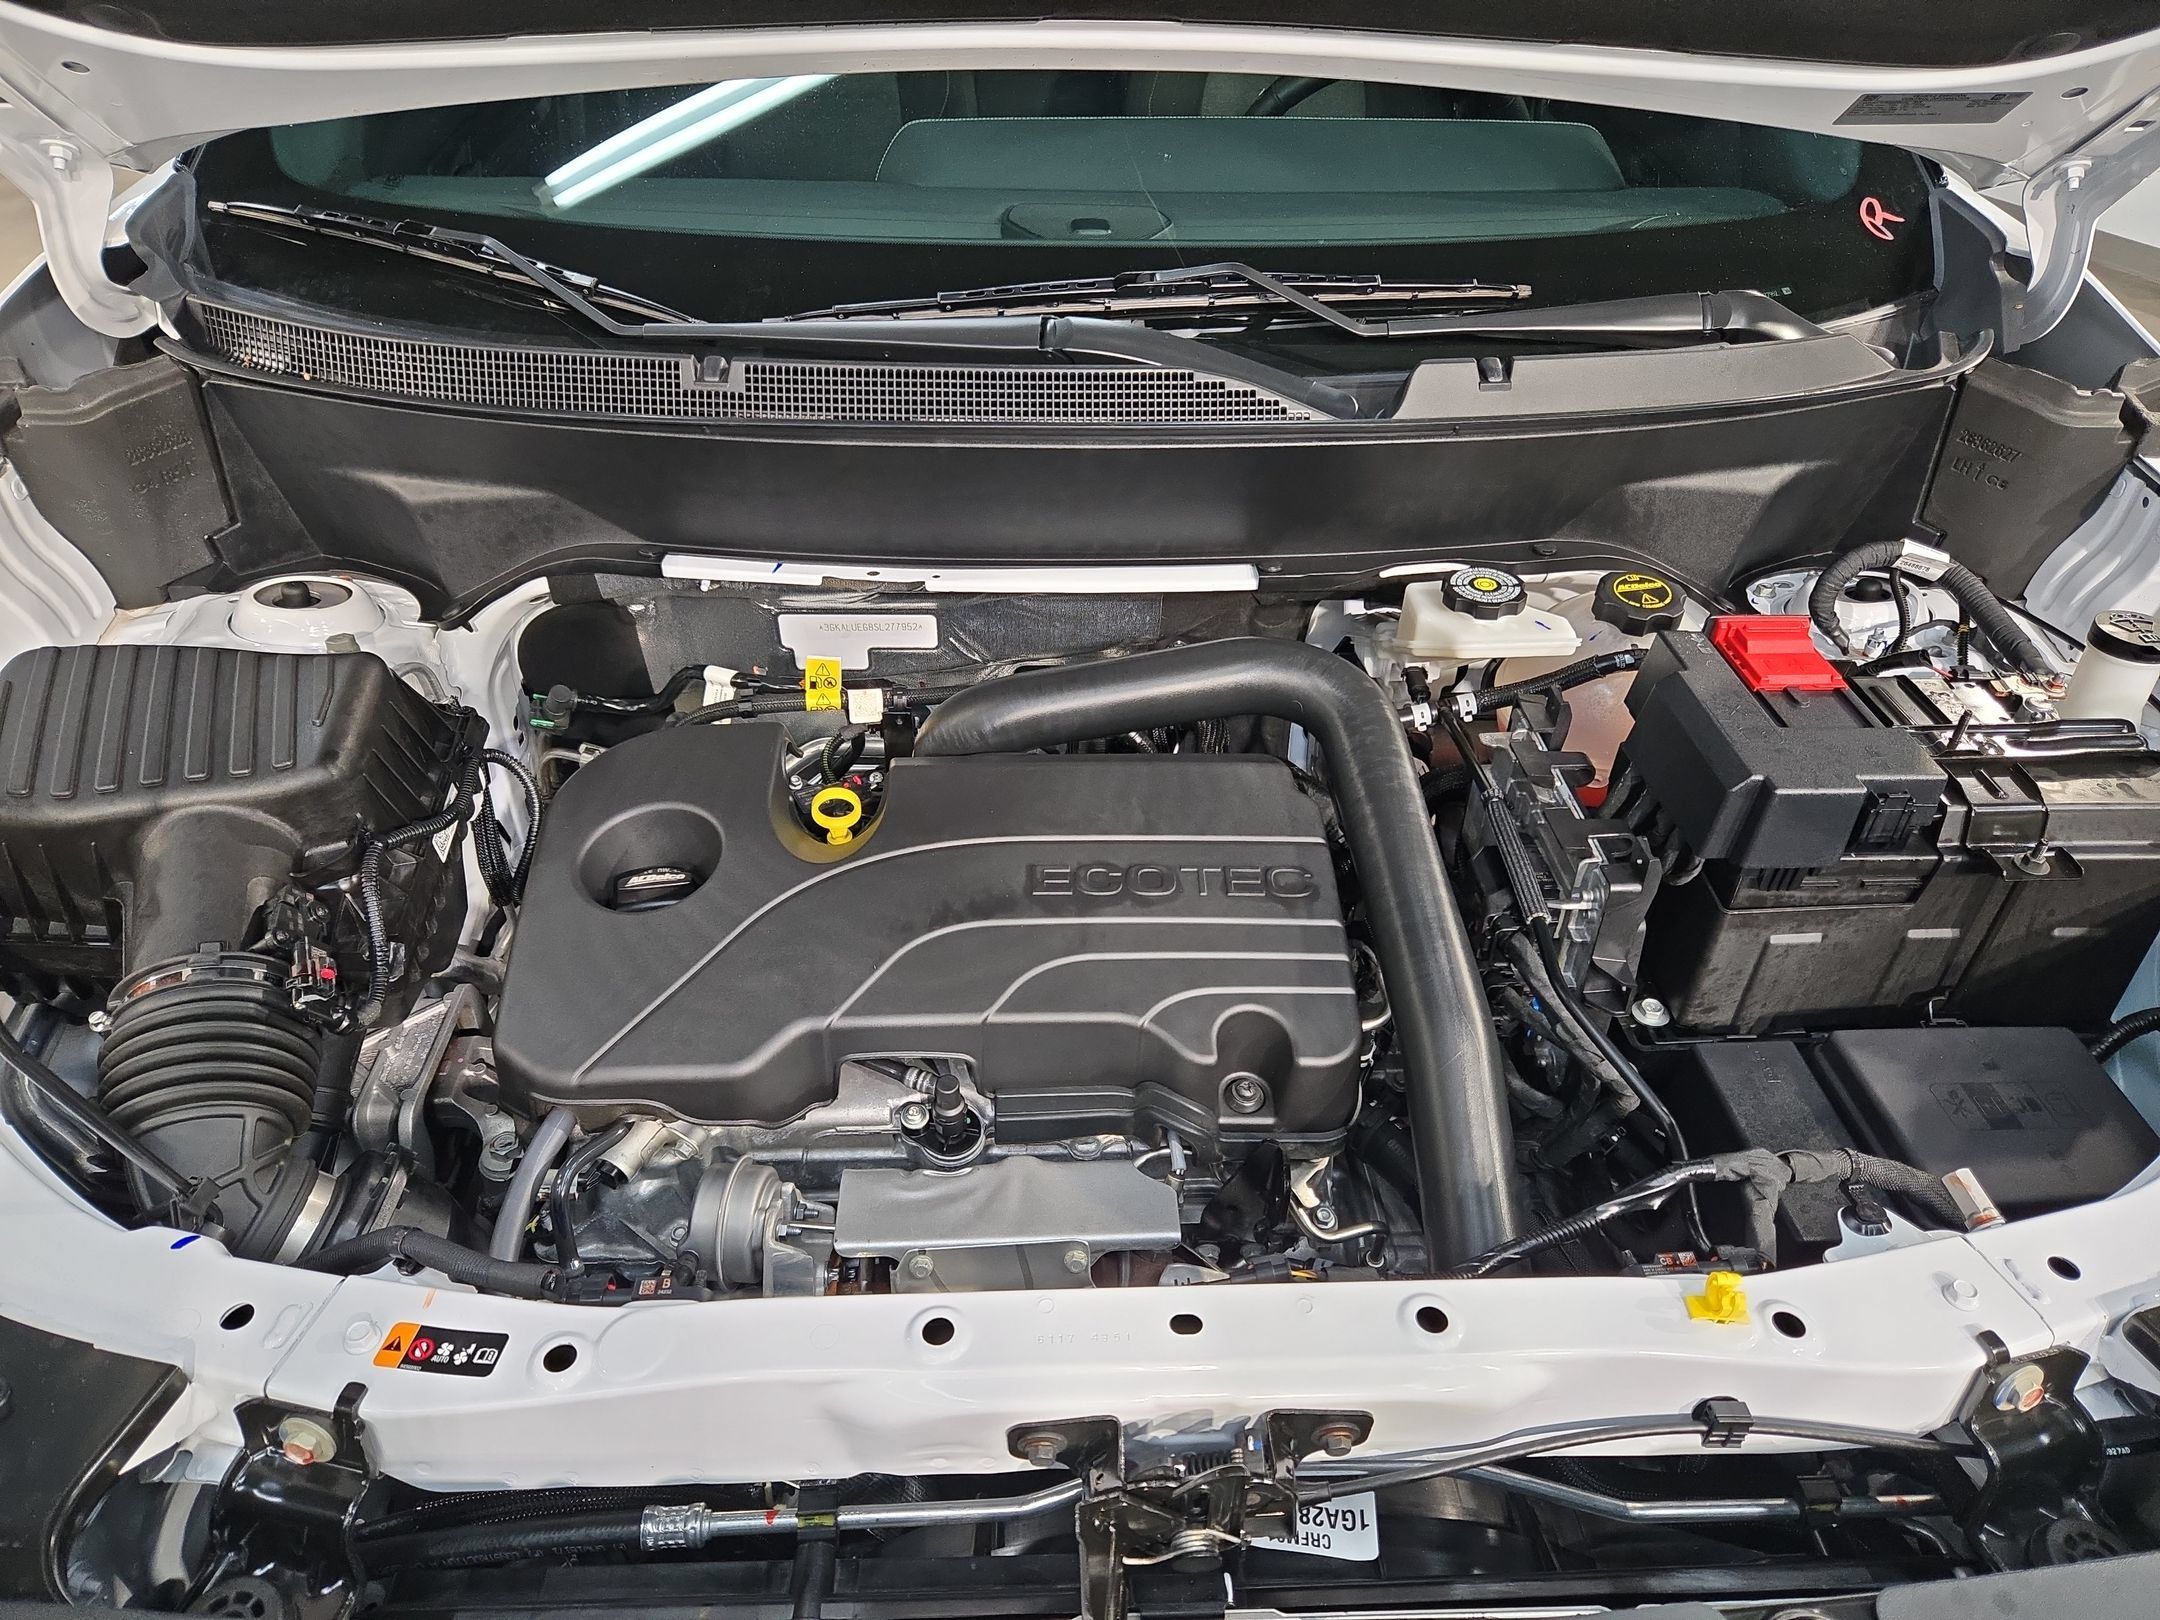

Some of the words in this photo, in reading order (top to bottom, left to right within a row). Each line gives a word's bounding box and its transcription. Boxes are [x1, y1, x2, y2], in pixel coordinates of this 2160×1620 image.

[1029, 863, 1317, 899] ECOTEC
[430, 1354, 450, 1364] AUTO
[1299, 1505, 1370, 1532] 1GA28
